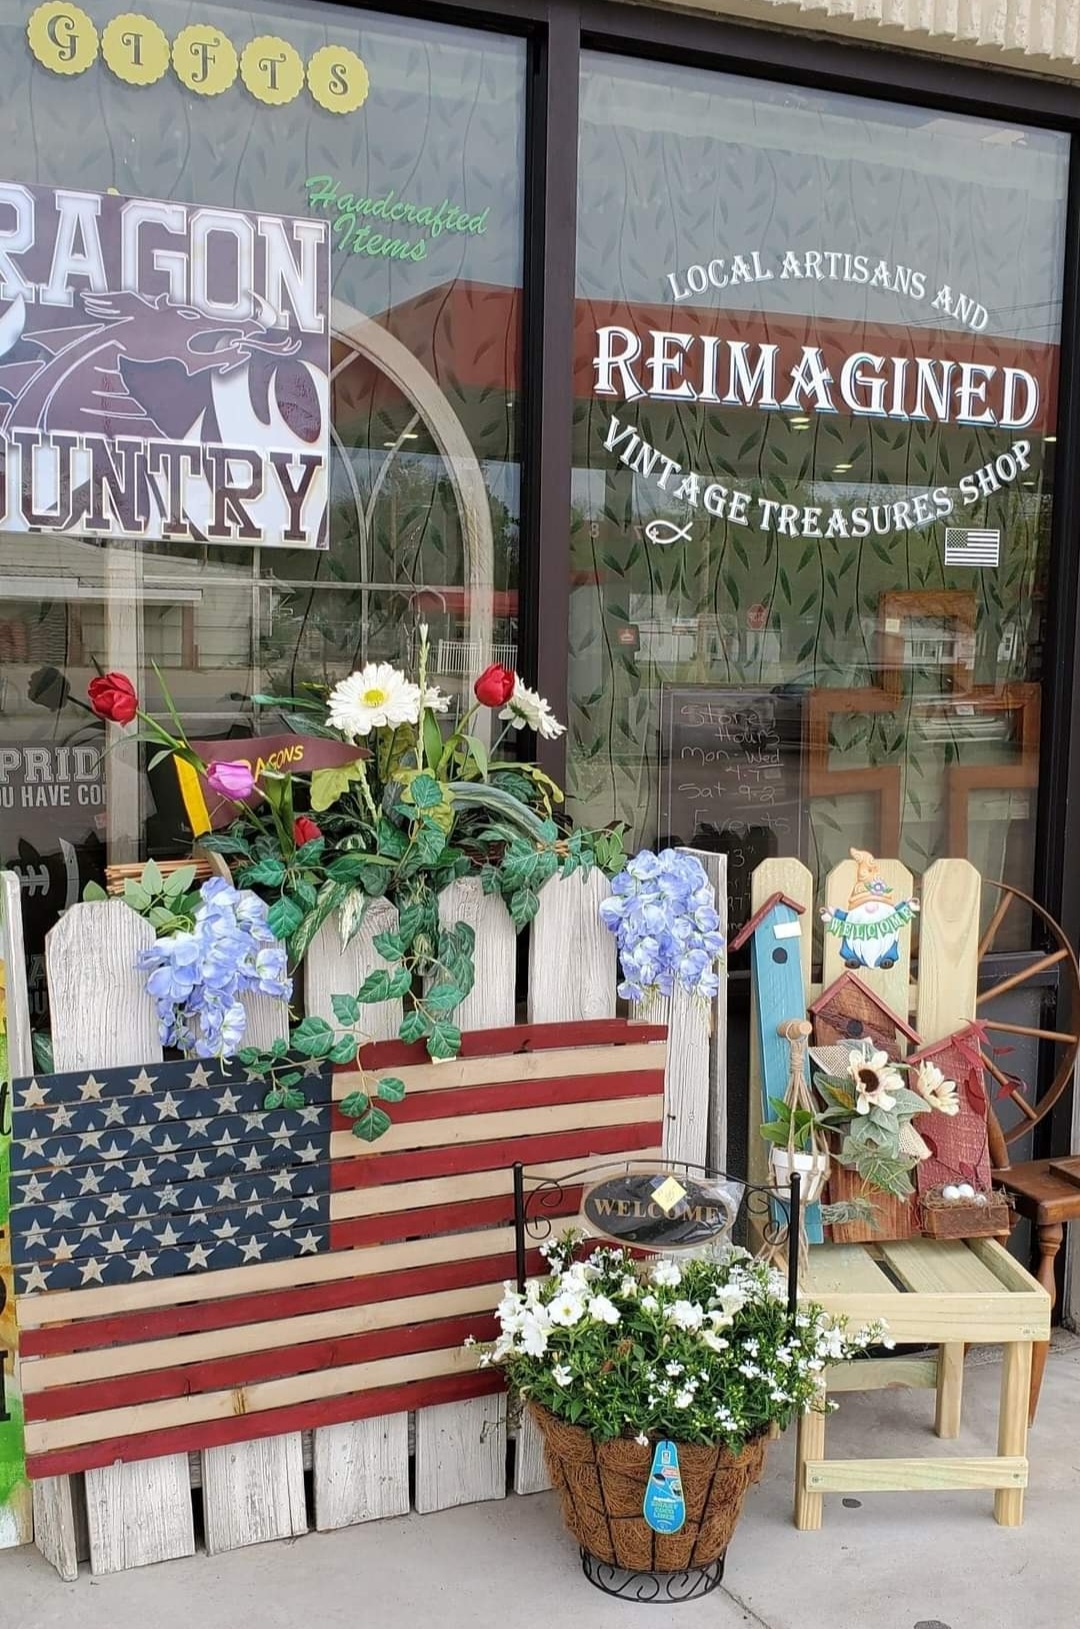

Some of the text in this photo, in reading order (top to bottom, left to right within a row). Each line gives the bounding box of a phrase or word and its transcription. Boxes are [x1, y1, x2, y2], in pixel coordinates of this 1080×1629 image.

[47, 14, 348, 96] GIFTS
[305, 174, 490, 238] Handcrafted
[333, 212, 428, 261] Items
[666, 250, 990, 332] LOCAL ARTISANS AND
[592, 325, 1040, 429] REIMAGINED
[0, 426, 323, 542] UNTRY
[603, 415, 1032, 539] VINTAGE TREASURES SHOP
[715, 727, 780, 746] Hours
[0, 746, 106, 784] PRID
[232, 744, 305, 783] AGONS
[0, 784, 106, 808] U HAVE CO
[678, 782, 726, 800] Sat
[828, 906, 915, 939] WELCOME
[593, 1198, 719, 1224] WELCOME
